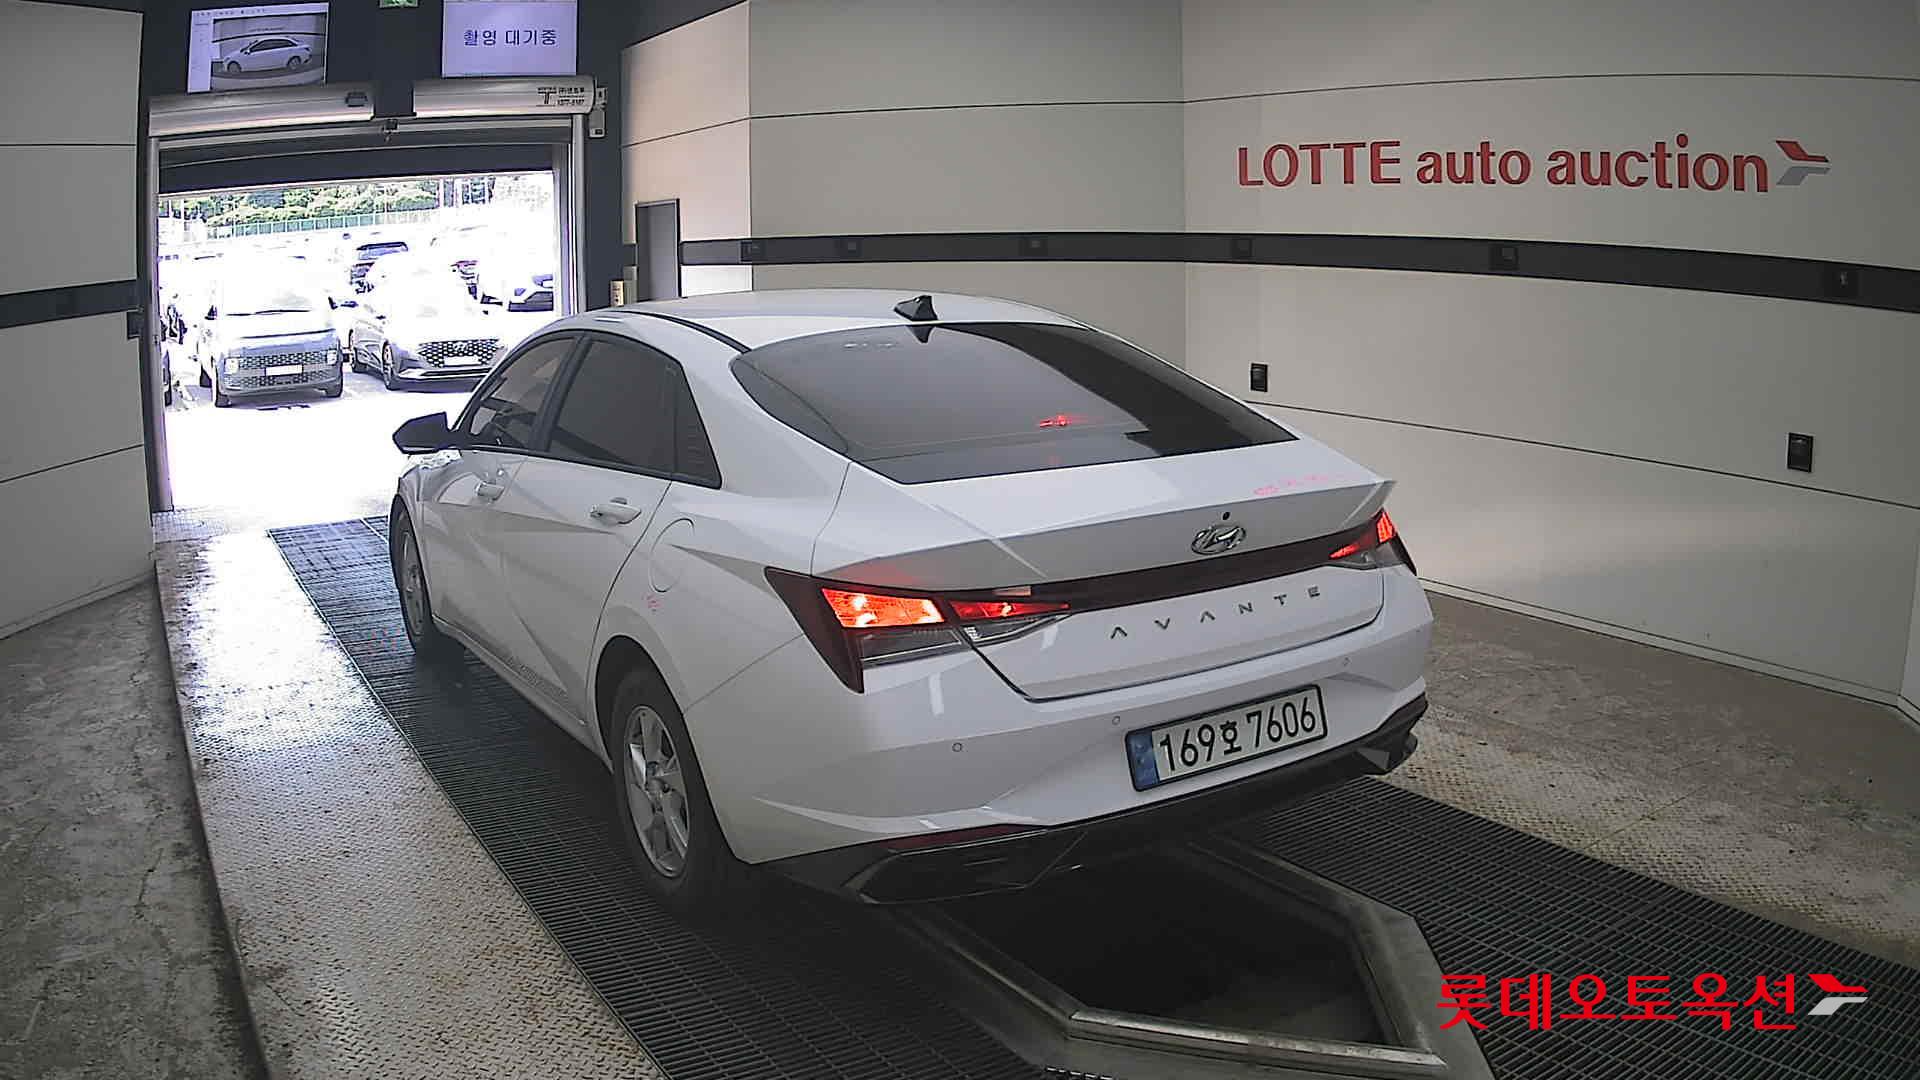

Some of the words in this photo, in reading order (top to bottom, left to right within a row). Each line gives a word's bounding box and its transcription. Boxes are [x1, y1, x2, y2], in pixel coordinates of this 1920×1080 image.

[464, 30, 497, 46] 촬영
[505, 30, 557, 46] 대기중
[1239, 140, 1400, 187] LOTTE
[1416, 141, 1532, 185] auto
[1546, 134, 1768, 193] auction
[1110, 586, 1321, 639] AVANTE
